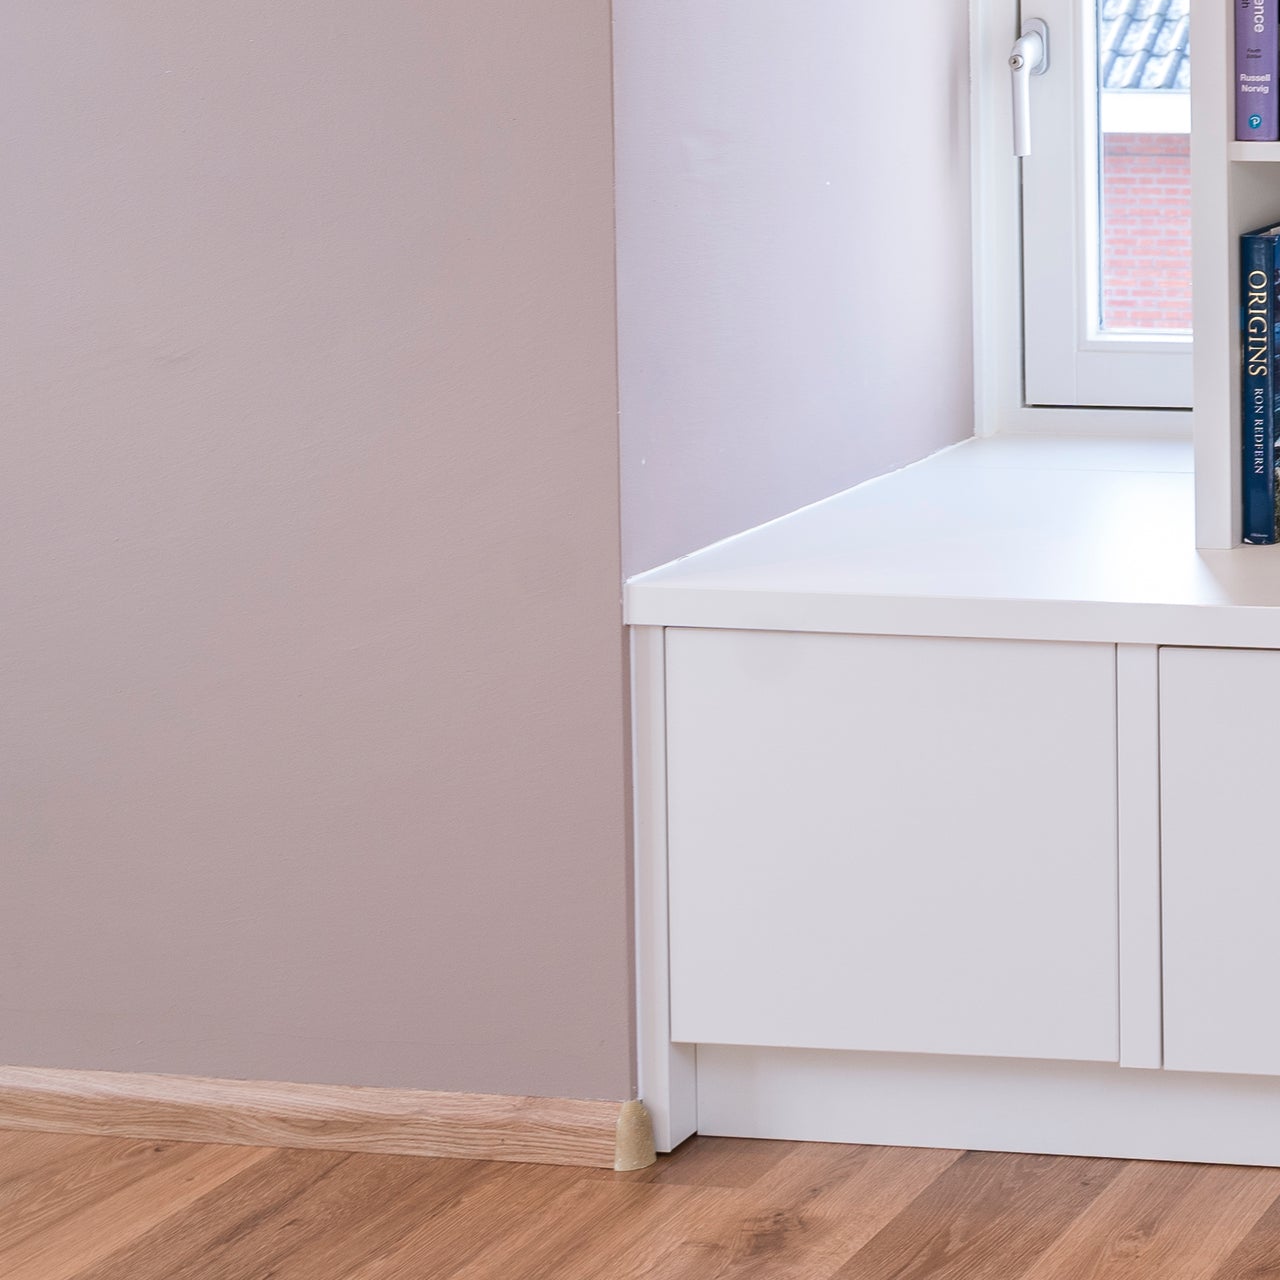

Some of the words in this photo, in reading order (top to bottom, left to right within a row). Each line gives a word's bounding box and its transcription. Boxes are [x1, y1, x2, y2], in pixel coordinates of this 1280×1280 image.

[1240, 74, 1271, 82] Russell
[1242, 84, 1269, 94] Norvig
[1248, 270, 1267, 376] ORIGINS
[1253, 387, 1263, 414] RON
[1254, 418, 1263, 475] REDFERN
